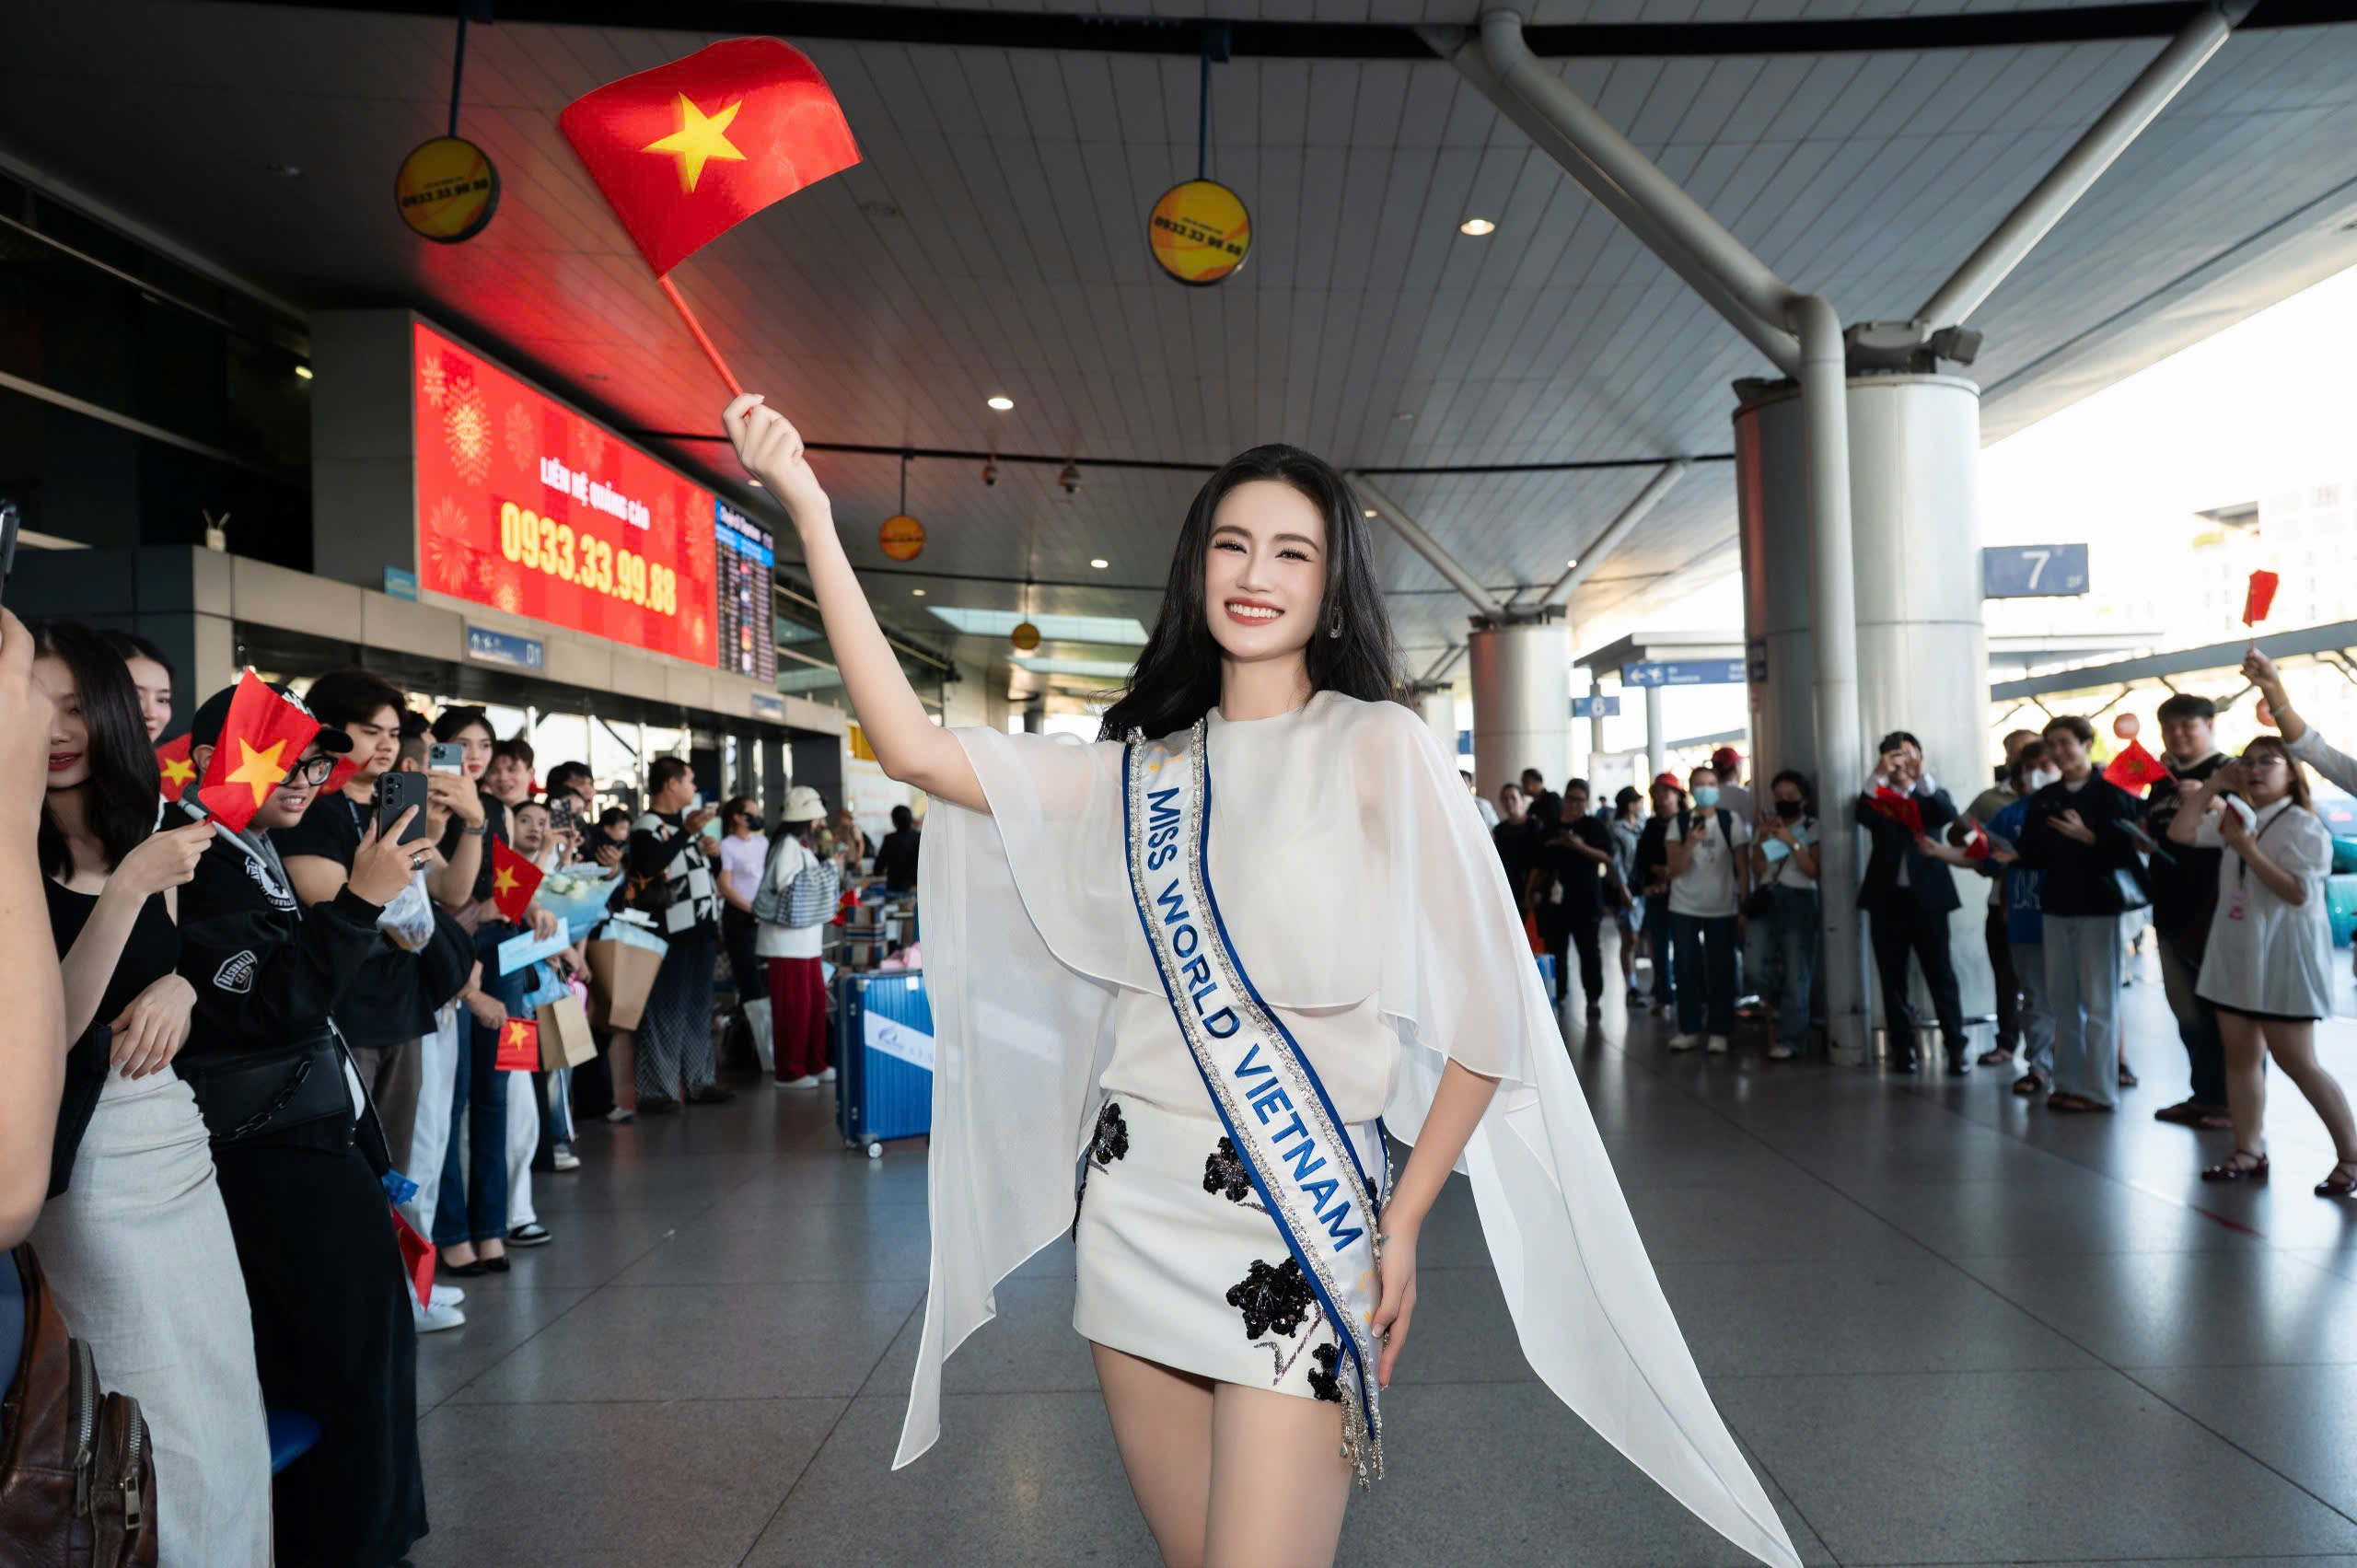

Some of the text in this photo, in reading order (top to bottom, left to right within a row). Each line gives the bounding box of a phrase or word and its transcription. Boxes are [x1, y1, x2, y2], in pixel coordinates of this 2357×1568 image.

[500, 501, 677, 617] 0933.33.99.88
[2022, 551, 2050, 589] 7
[526, 643, 542, 668] D1
[1146, 787, 1181, 871] MISS
[217, 953, 254, 987] BASEBALL
[1156, 877, 1241, 1040] WORLD
[1234, 1042, 1364, 1253] VIETNAM
